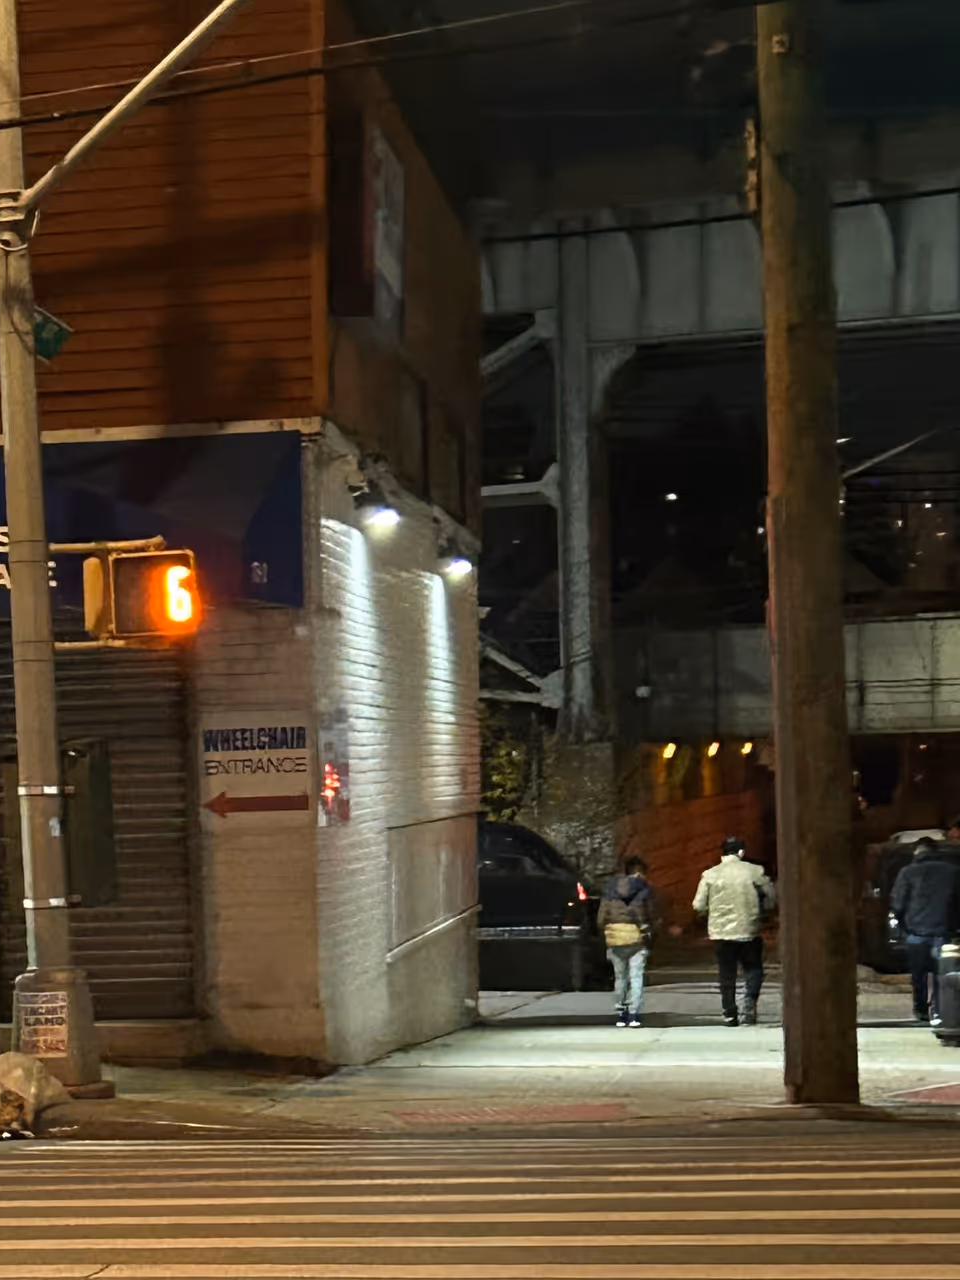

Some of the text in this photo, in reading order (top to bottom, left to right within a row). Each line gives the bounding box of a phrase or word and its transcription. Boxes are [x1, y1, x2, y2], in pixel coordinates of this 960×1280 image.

[166, 564, 194, 623] 6
[202, 726, 307, 753] WHEELCHAIR
[204, 756, 308, 777] ENTRANCE
